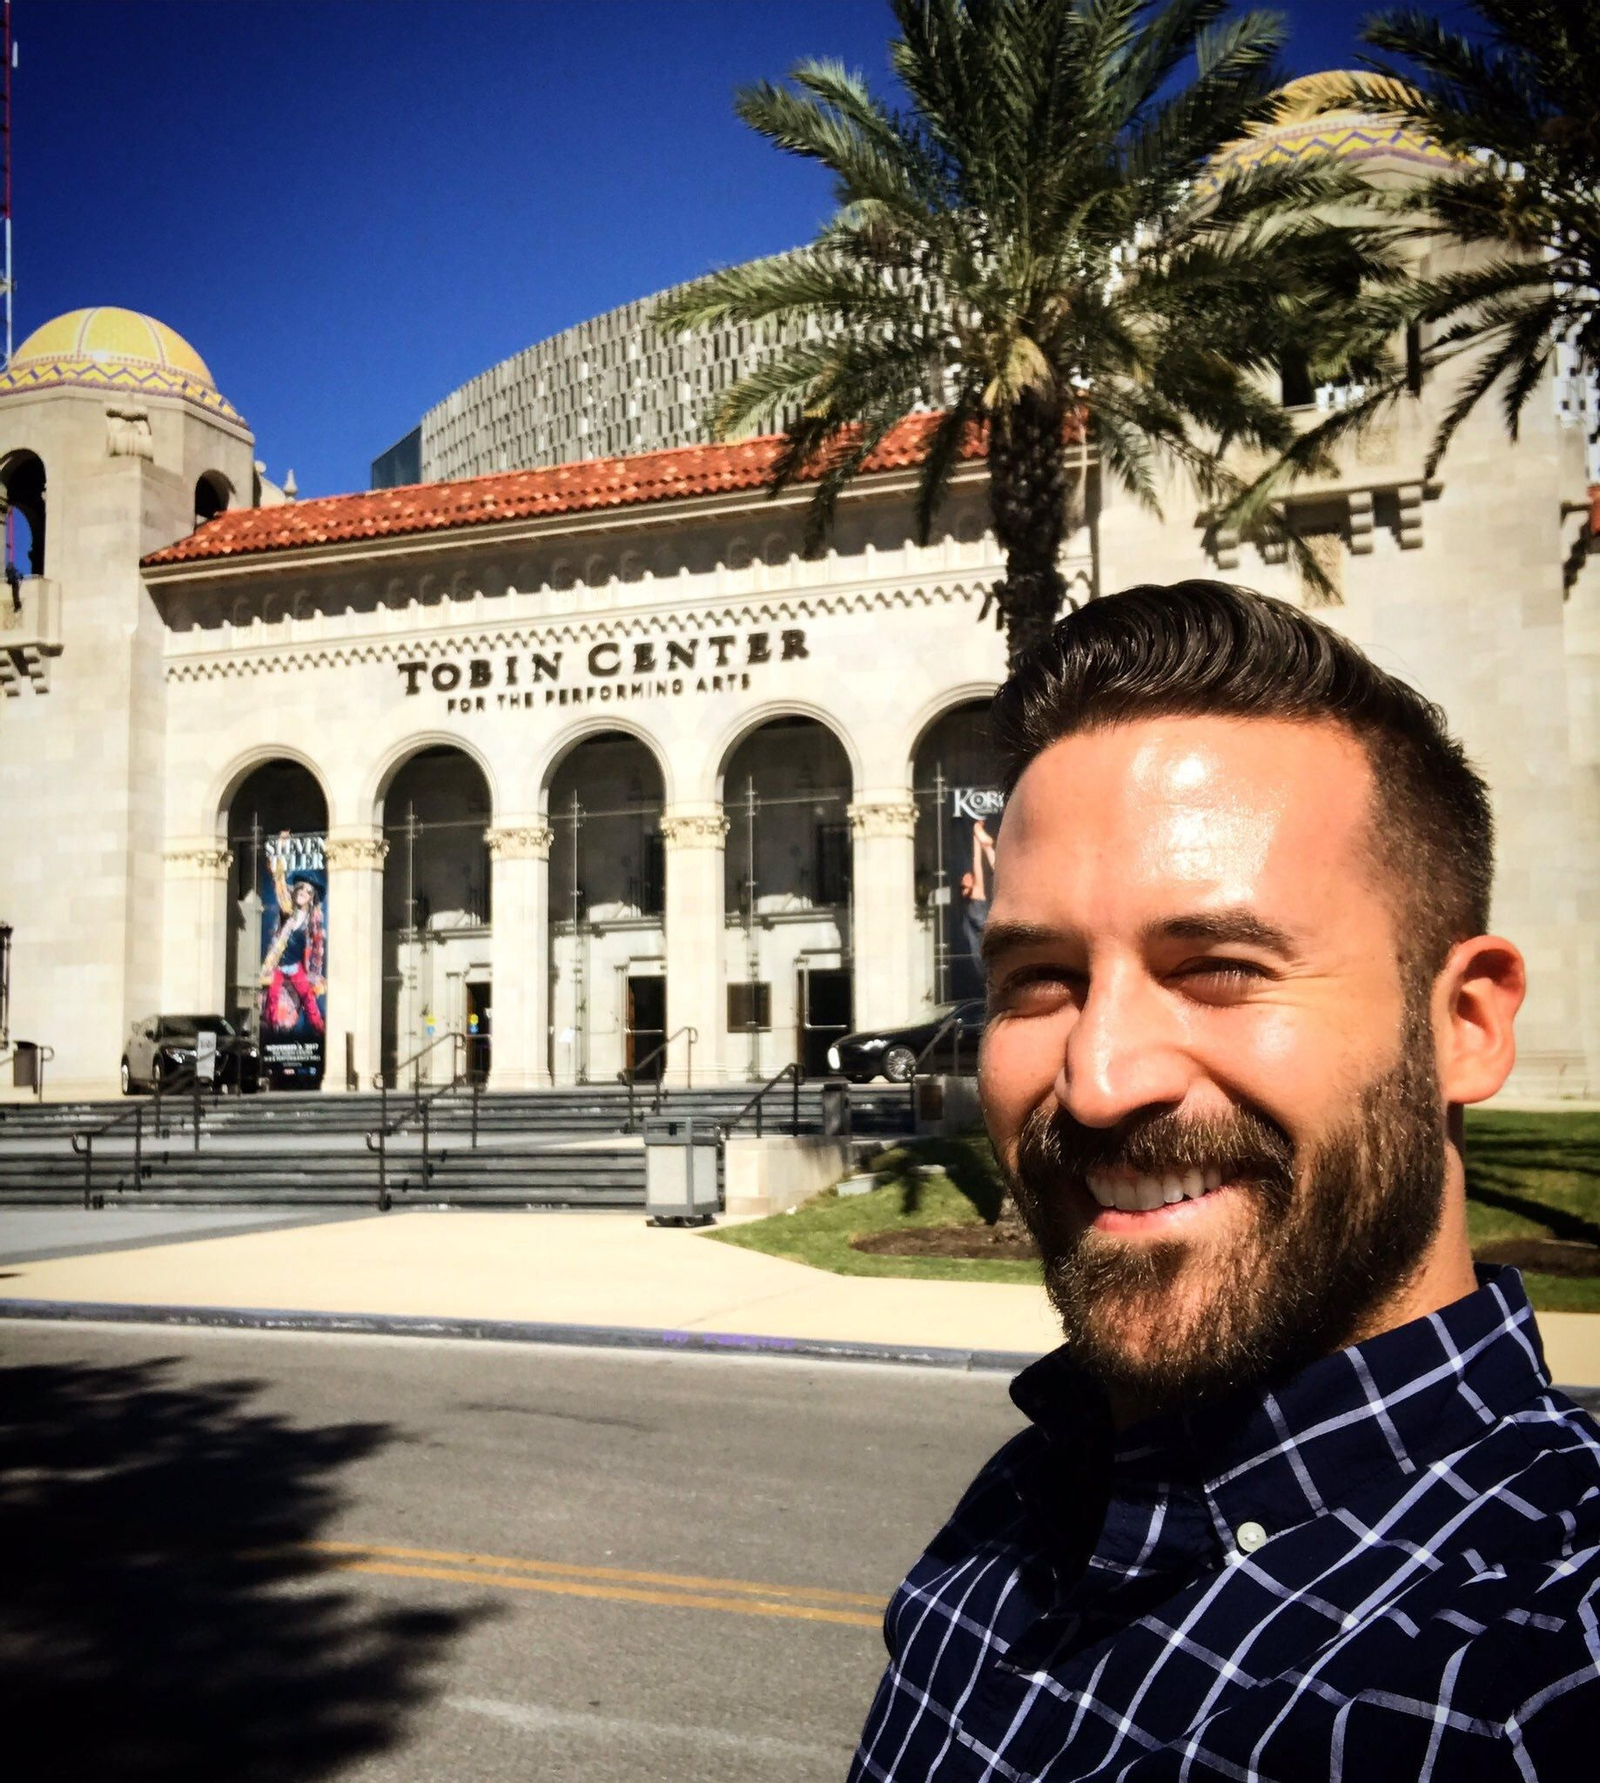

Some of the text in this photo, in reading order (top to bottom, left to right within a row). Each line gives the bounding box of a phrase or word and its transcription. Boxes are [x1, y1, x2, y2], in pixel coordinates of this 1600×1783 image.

[397, 628, 811, 696] TOBIN CENTER
[447, 672, 751, 715] FOR THE PERFORMING ARTS
